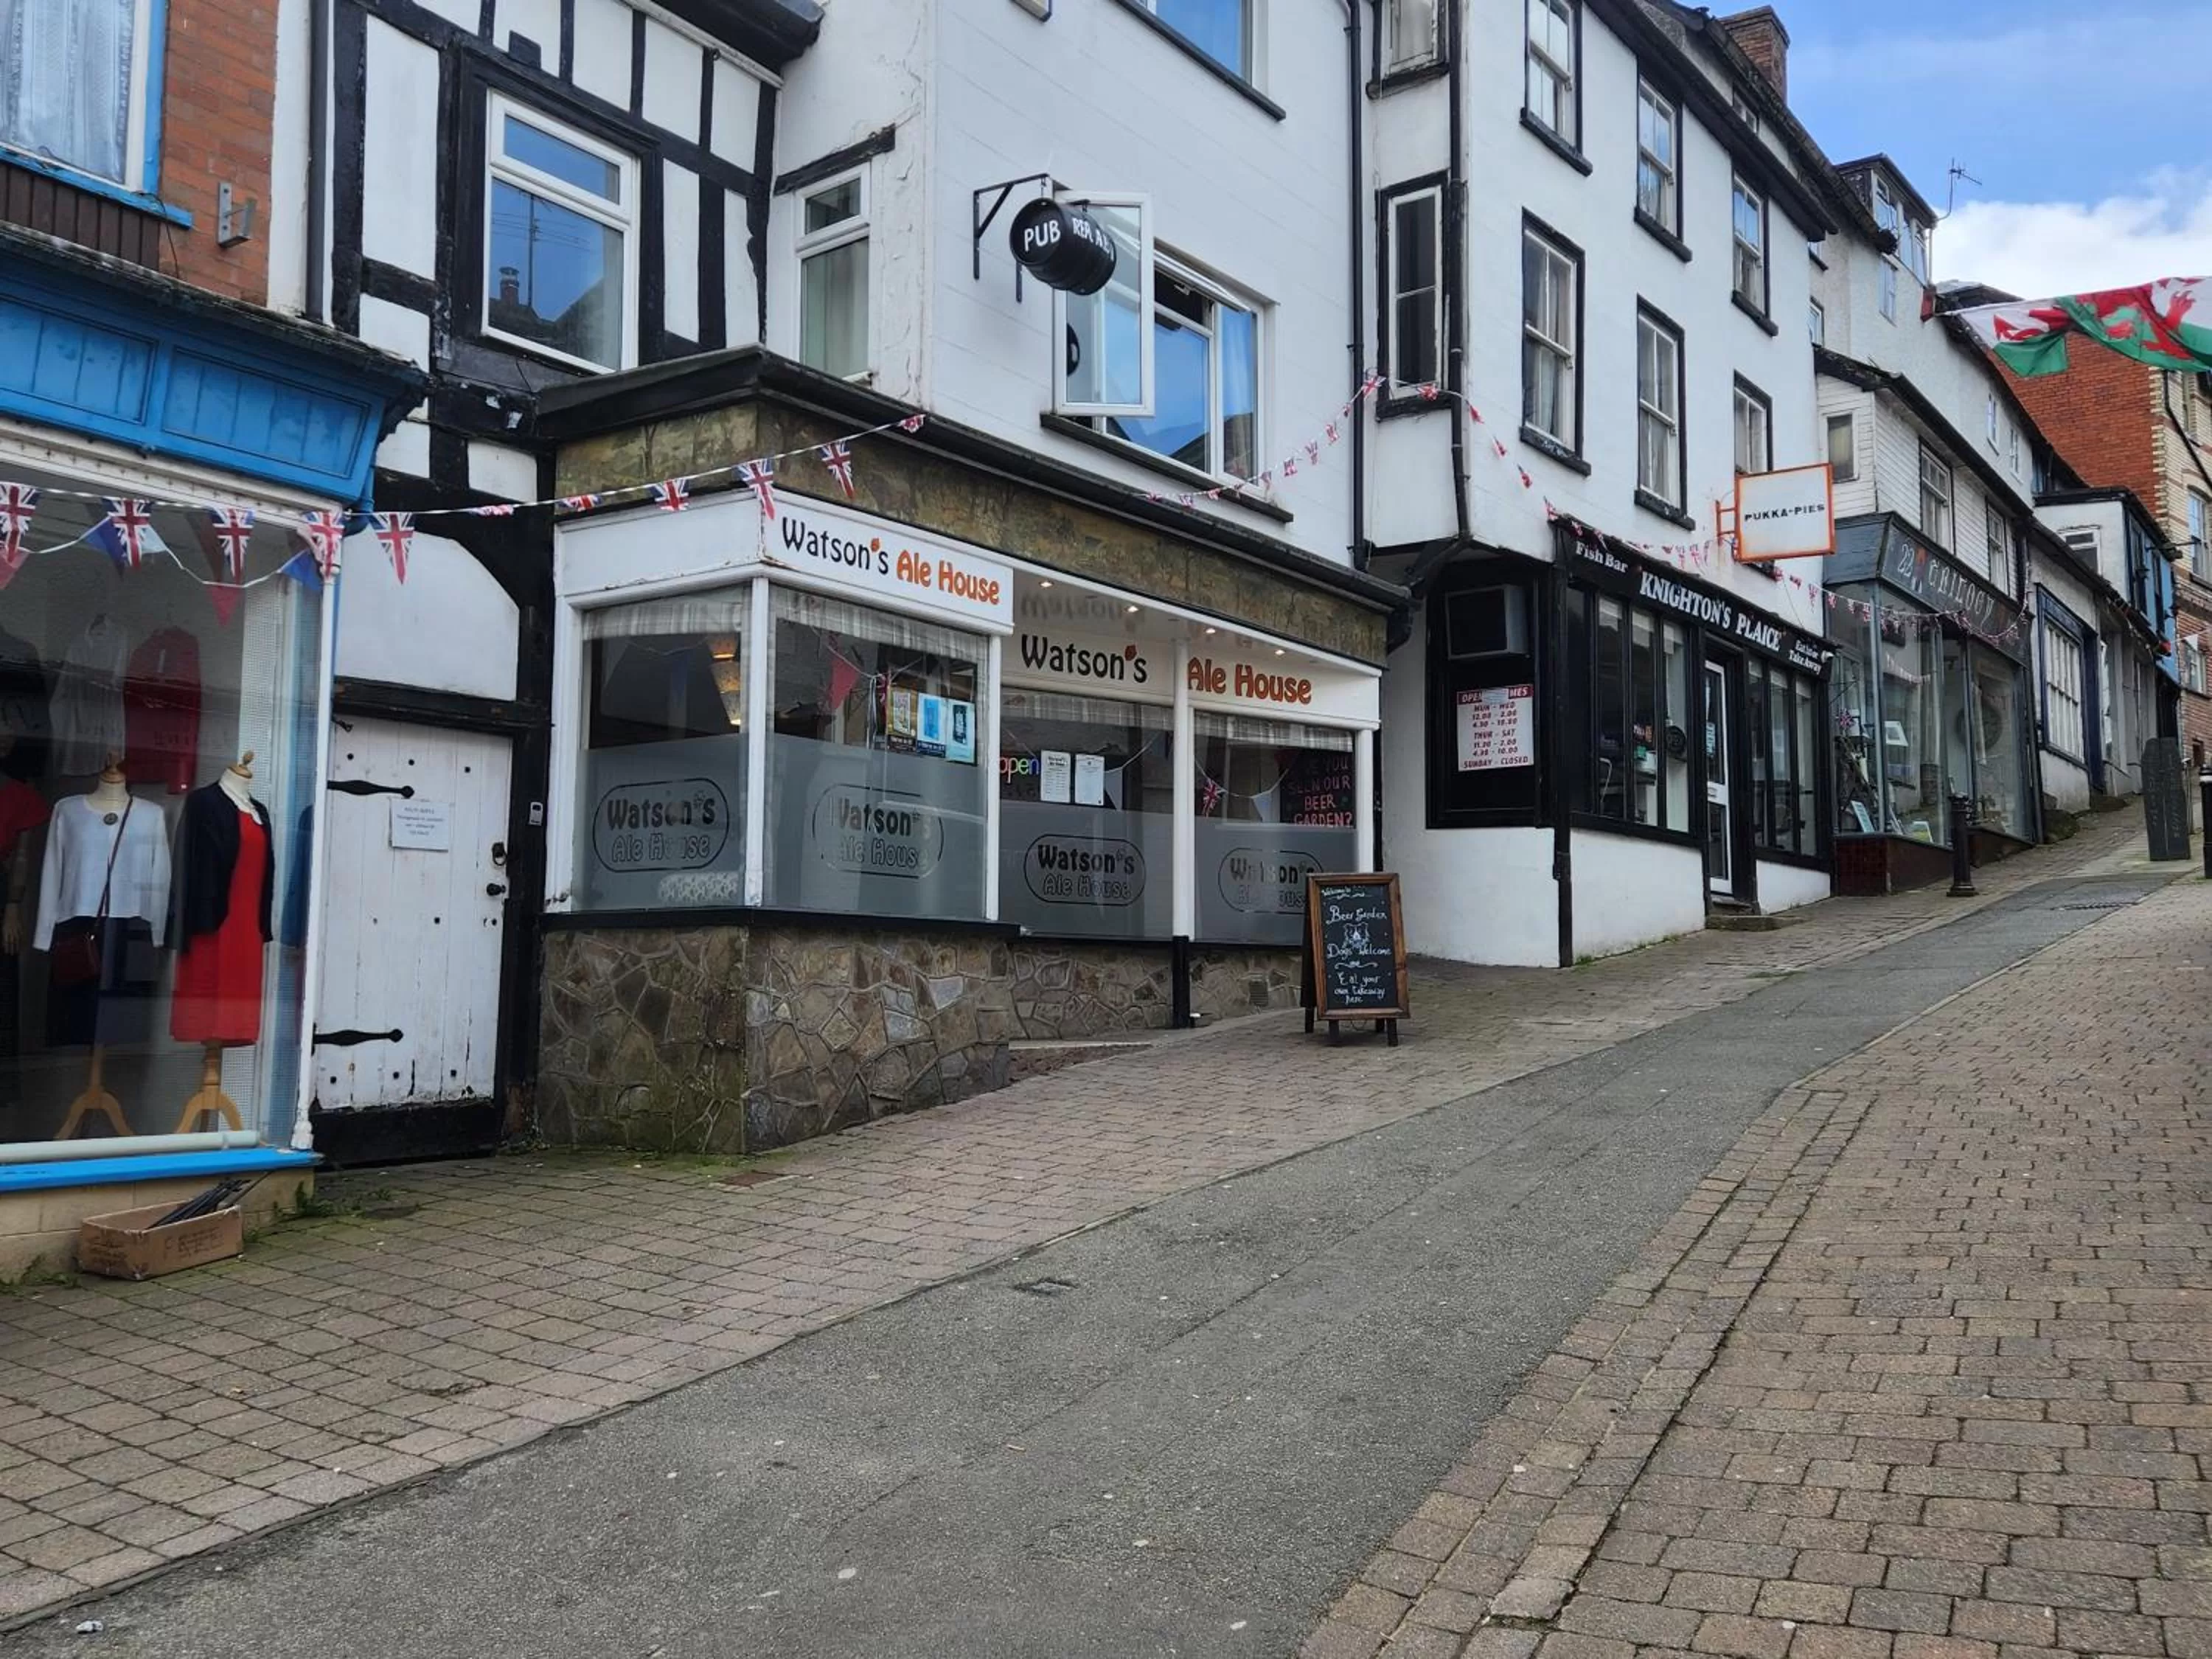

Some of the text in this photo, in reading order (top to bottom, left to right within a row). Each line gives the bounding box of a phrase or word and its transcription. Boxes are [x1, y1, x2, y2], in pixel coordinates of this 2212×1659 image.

[1024, 220, 1060, 251] PUB
[1745, 504, 1825, 521] PUKKA-PIES
[782, 517, 999, 605] Watson's Ale House
[1576, 540, 1628, 573] Fish Bar
[1897, 543, 1915, 577] 22
[1640, 571, 1782, 652] KNIGHTON'S PLAICE
[1021, 634, 1312, 705] Watson's Ale House
[1464, 757, 1528, 768] SUNDAY CLOSED
[1304, 794, 1337, 811] BEER
[1294, 812, 1354, 827] GARDEN?
[611, 834, 644, 863] Ale
[1038, 844, 1135, 874] Watson's
[1043, 872, 1132, 900] Ale House
[1326, 905, 1387, 925] Beer Garden
[1326, 943, 1391, 960] Dogs Welcome
[1360, 976, 1380, 987] your
